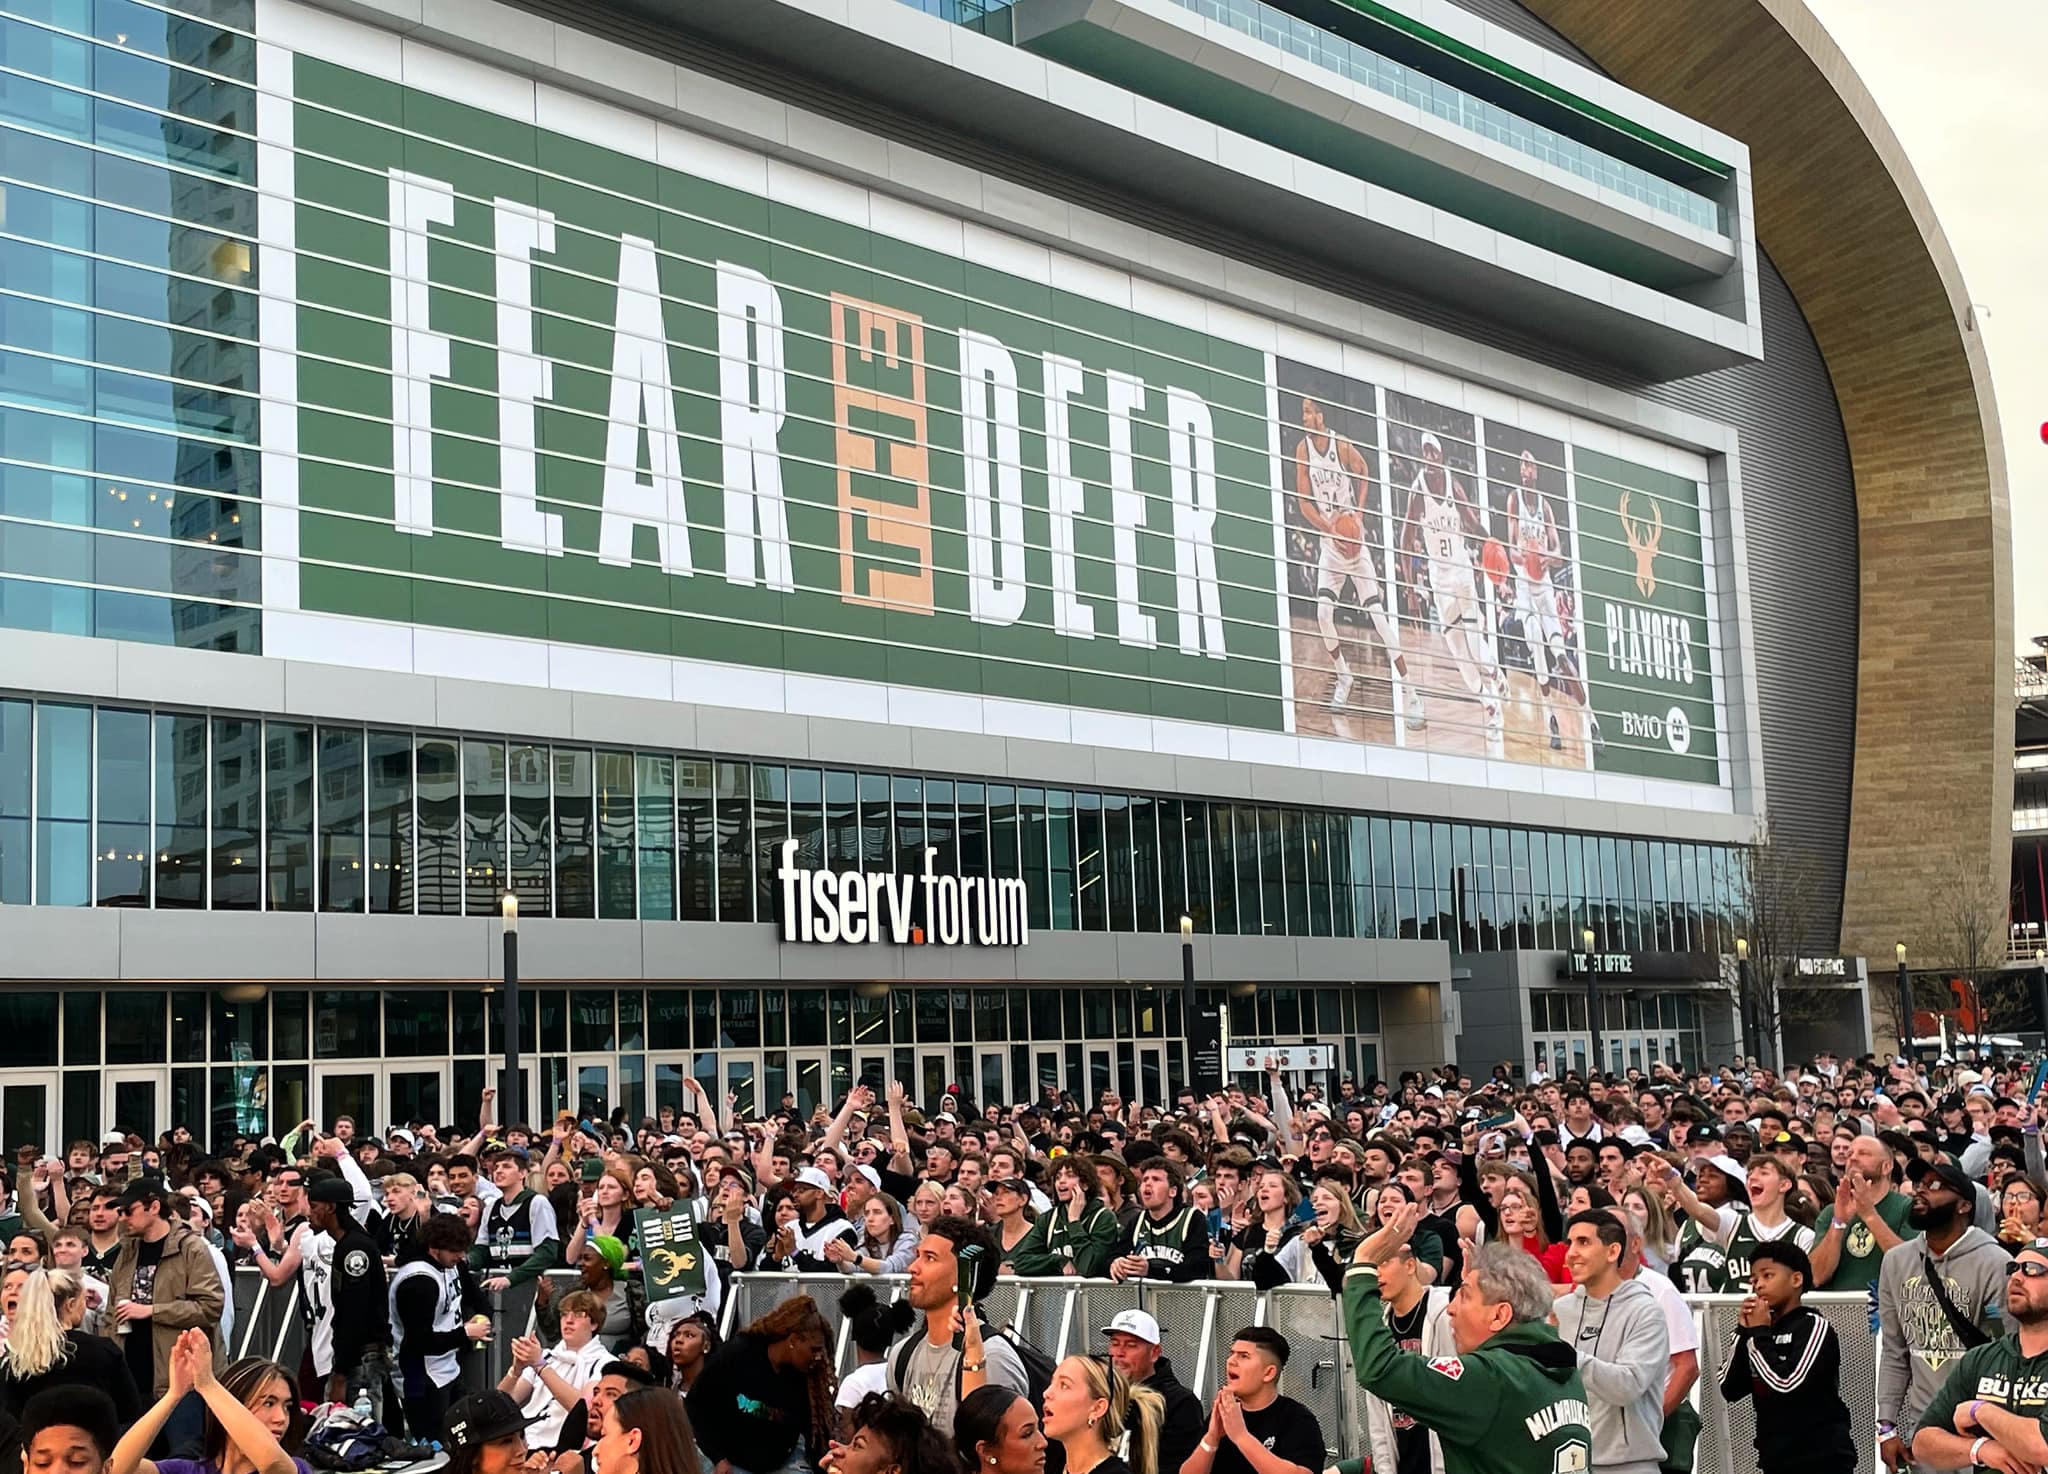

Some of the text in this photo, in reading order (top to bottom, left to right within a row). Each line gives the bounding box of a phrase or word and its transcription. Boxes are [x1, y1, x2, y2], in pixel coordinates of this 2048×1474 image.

[388, 167, 1228, 661] FEAR THE DEER
[1440, 538, 1453, 557] 21
[1605, 602, 1693, 684] PLAYOFFS
[1621, 711, 1662, 739] BMO
[1574, 954, 1632, 972] TICET OFFICE
